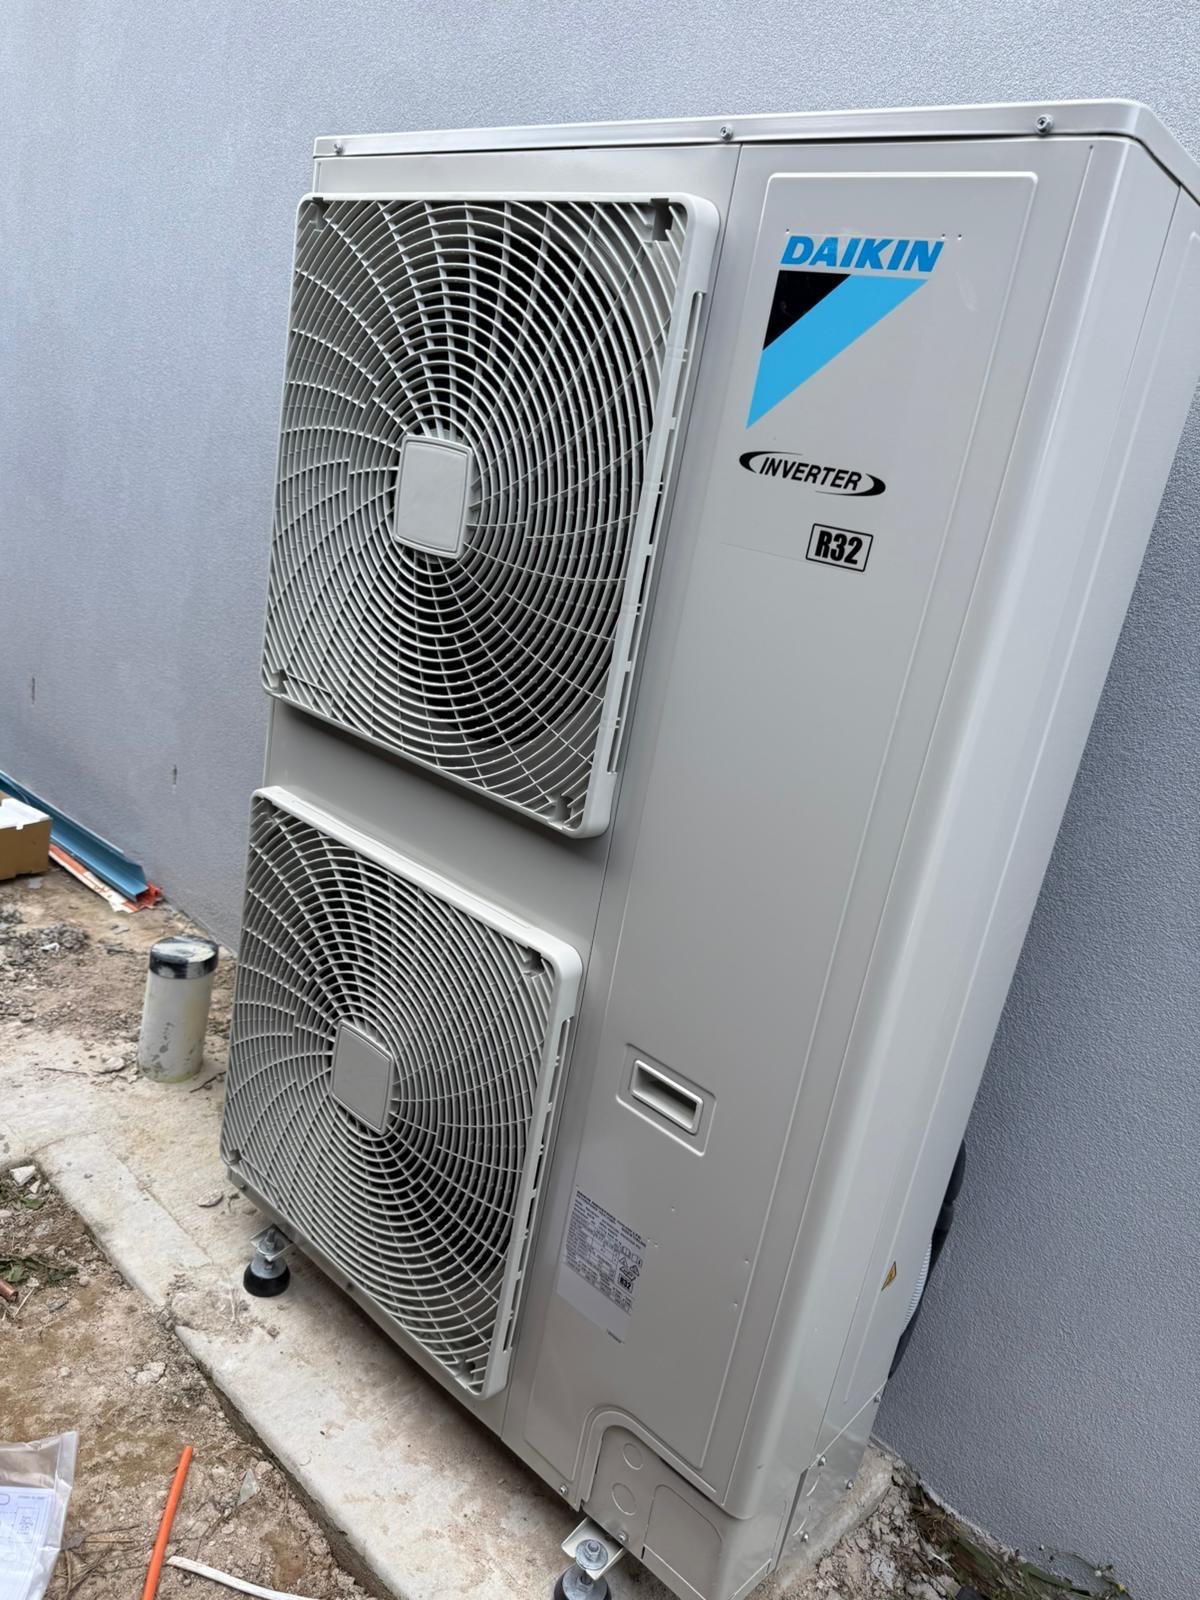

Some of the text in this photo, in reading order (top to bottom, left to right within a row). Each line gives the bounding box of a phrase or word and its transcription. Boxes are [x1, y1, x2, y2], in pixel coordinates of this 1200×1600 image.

[780, 235, 945, 272] DAIKIN
[759, 456, 862, 491] INVERTER
[814, 530, 864, 565] R32
